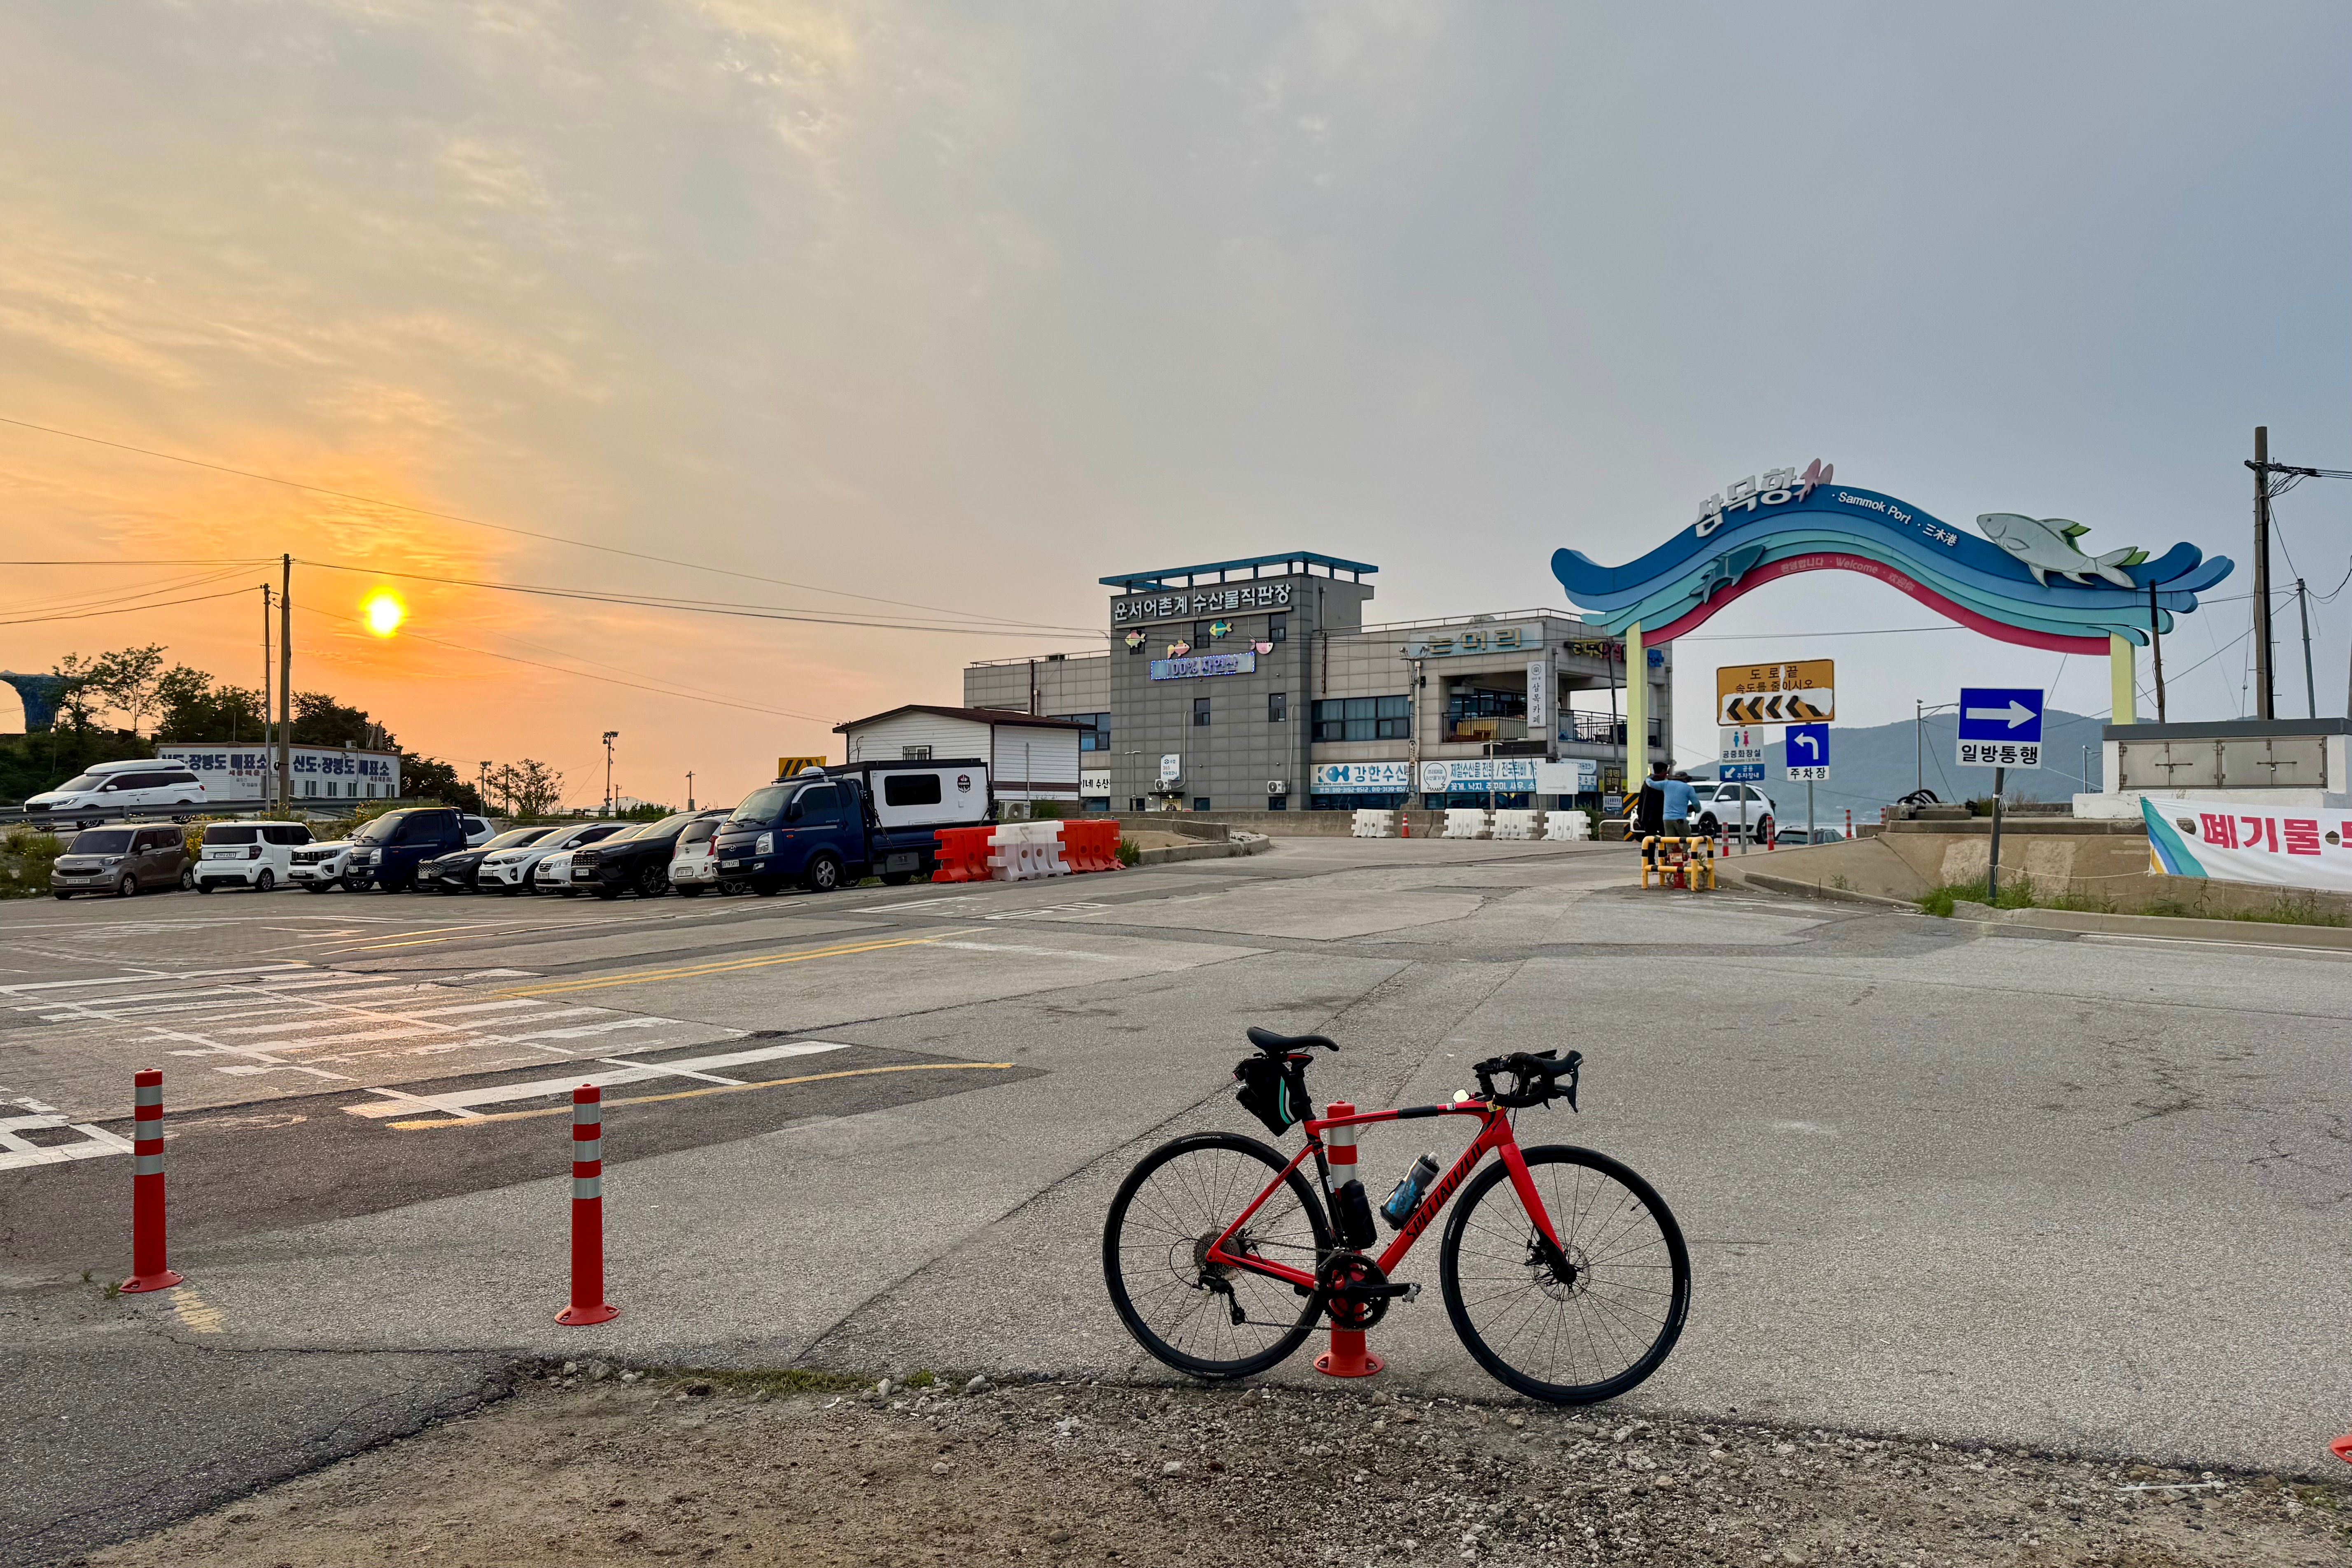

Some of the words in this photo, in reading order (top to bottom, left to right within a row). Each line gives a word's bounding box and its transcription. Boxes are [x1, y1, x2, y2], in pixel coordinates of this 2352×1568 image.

[1693, 467, 1797, 537] 삼목항
[1838, 492, 1886, 512] Sammok
[1887, 506, 1912, 525] Port
[1923, 523, 1958, 546] 三木港
[1836, 557, 1878, 574] Welcome
[1115, 595, 1188, 621] 운서어촌계
[1193, 583, 1291, 613] 수산물직판장
[1166, 661, 1197, 676] 100%
[1201, 656, 1238, 673] 자연산
[1736, 682, 1766, 693] 속도를
[1771, 679, 1814, 692] 줄이시오
[1532, 682, 1541, 725] 삼목카페
[1961, 744, 2038, 765] 일방통행
[1354, 765, 1407, 782] 강한수산
[1790, 767, 1826, 779] 주차장
[2199, 813, 2322, 856] 폐기물
[1406, 1142, 1482, 1238] SPECIALIZED
